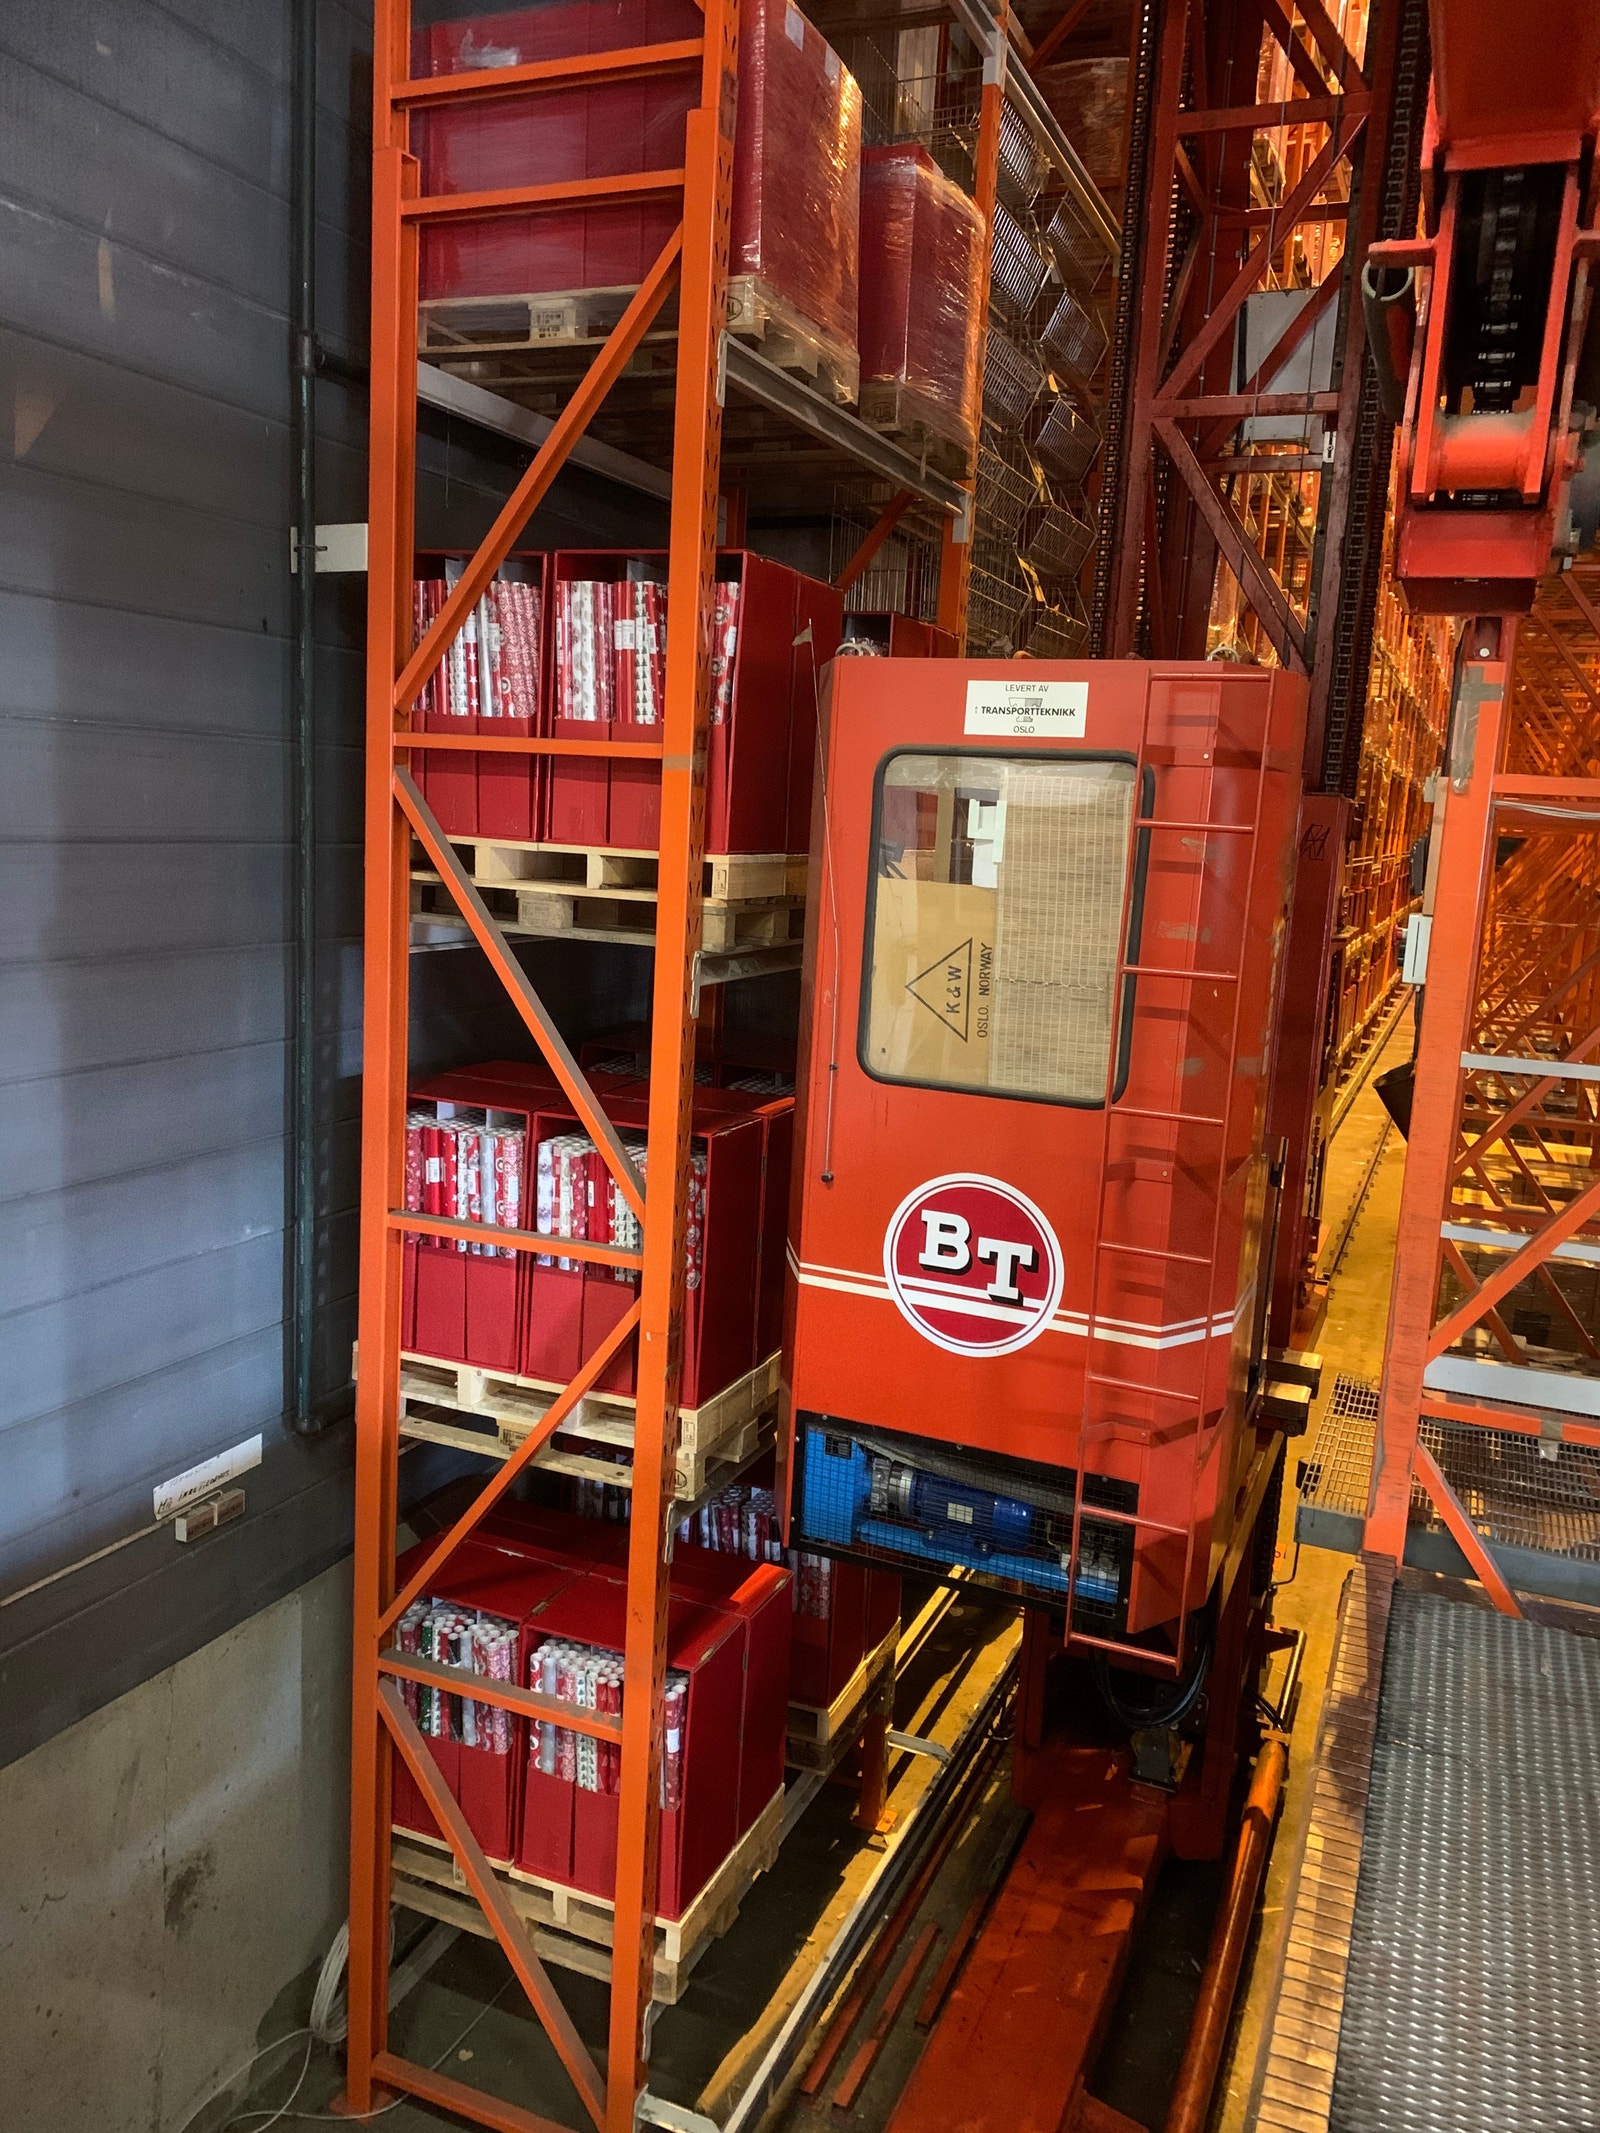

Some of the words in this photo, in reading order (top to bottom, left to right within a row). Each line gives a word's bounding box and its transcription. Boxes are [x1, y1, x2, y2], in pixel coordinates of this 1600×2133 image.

[1005, 684, 1037, 692] LEVERT
[1038, 684, 1050, 693] AV
[981, 706, 1076, 717] TRANSPORTTEKNIKK
[1013, 725, 1035, 734] OSLO
[947, 965, 962, 982] W
[978, 942, 993, 996] NORWAY
[946, 986, 961, 999] &
[946, 1002, 961, 1014] K
[918, 1209, 1039, 1307] BT
